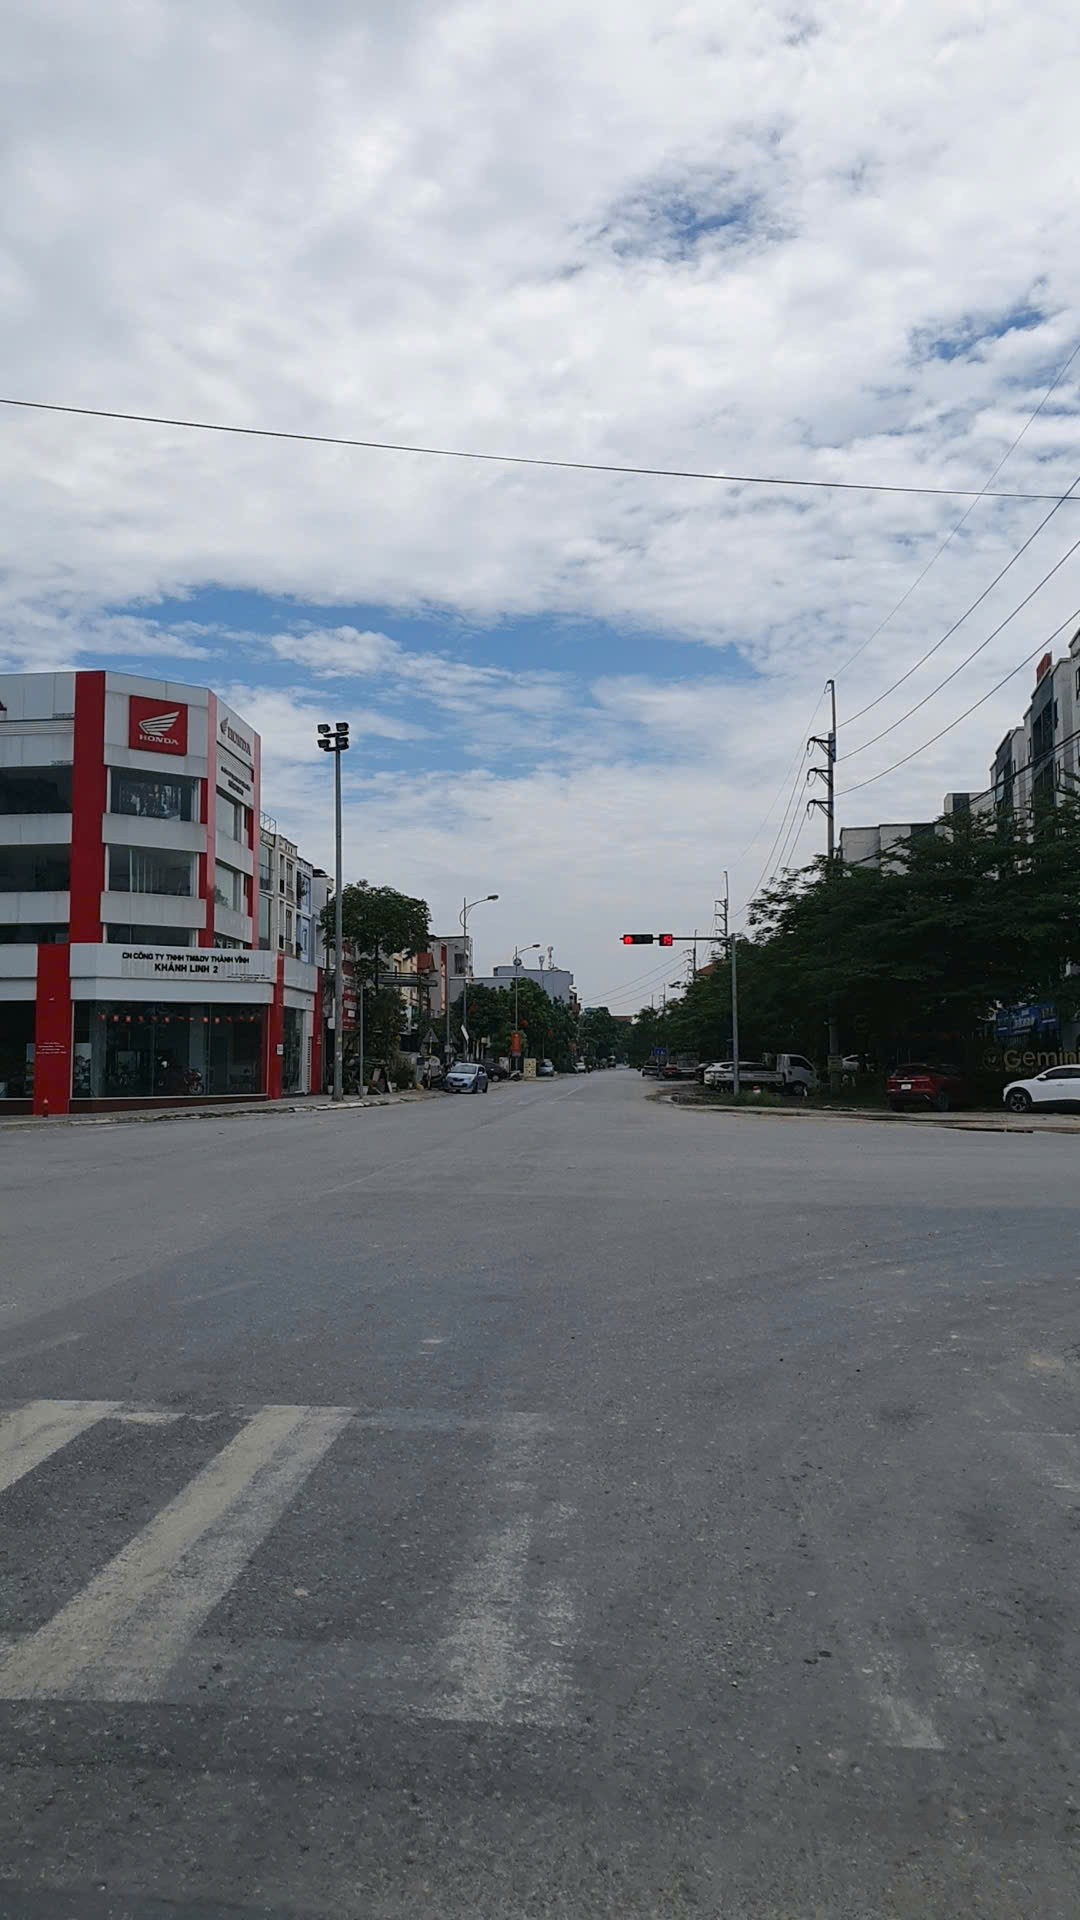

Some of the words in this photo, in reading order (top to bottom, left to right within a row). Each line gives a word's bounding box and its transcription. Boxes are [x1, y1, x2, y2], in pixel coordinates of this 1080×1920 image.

[139, 734, 179, 745] HONDA
[133, 950, 154, 960] CÔNG
[166, 953, 184, 961] TNHH
[190, 965, 209, 973] LINH
